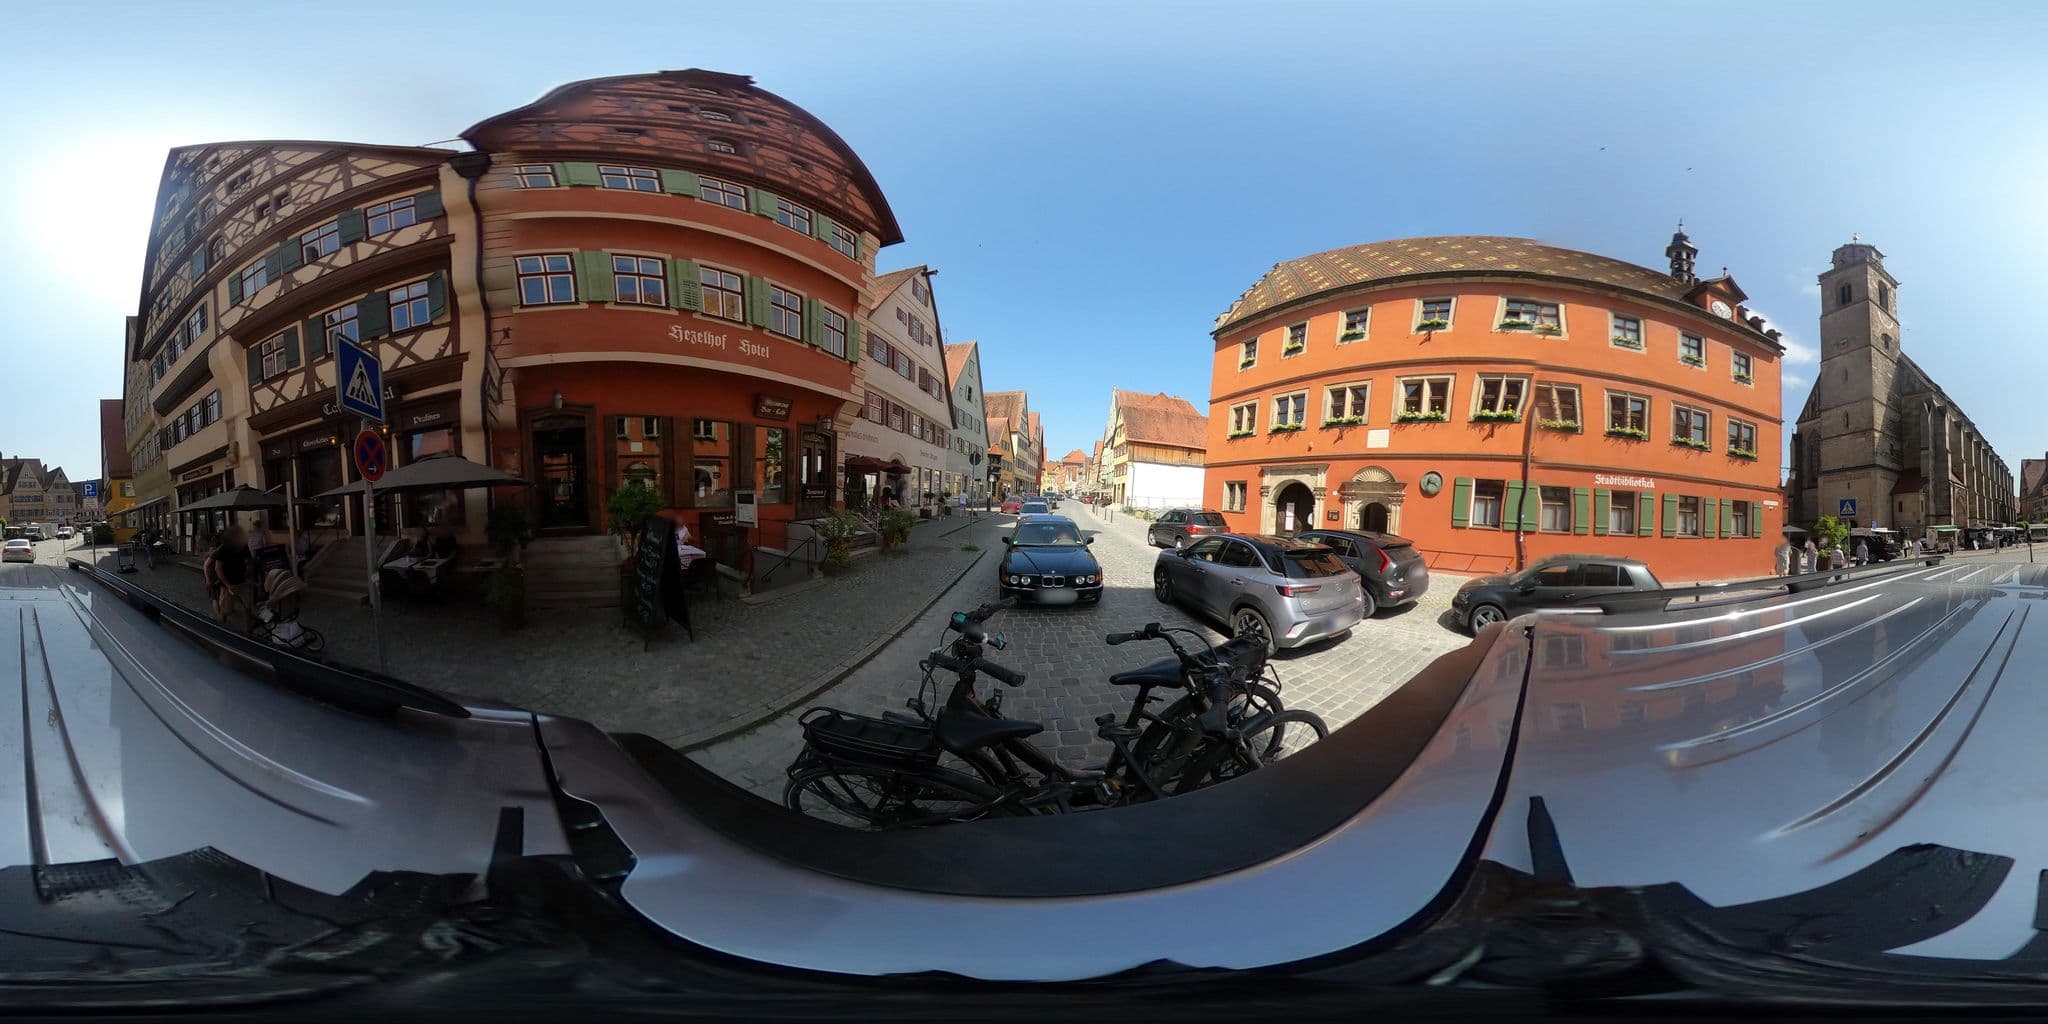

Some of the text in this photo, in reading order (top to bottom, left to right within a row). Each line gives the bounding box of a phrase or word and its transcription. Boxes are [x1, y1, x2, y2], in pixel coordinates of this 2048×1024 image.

[668, 325, 769, 358] Hezelhof Hotel
[413, 413, 441, 425] Pralinen
[1595, 474, 1655, 488] Stadtbibliothek
[84, 484, 93, 495] P
